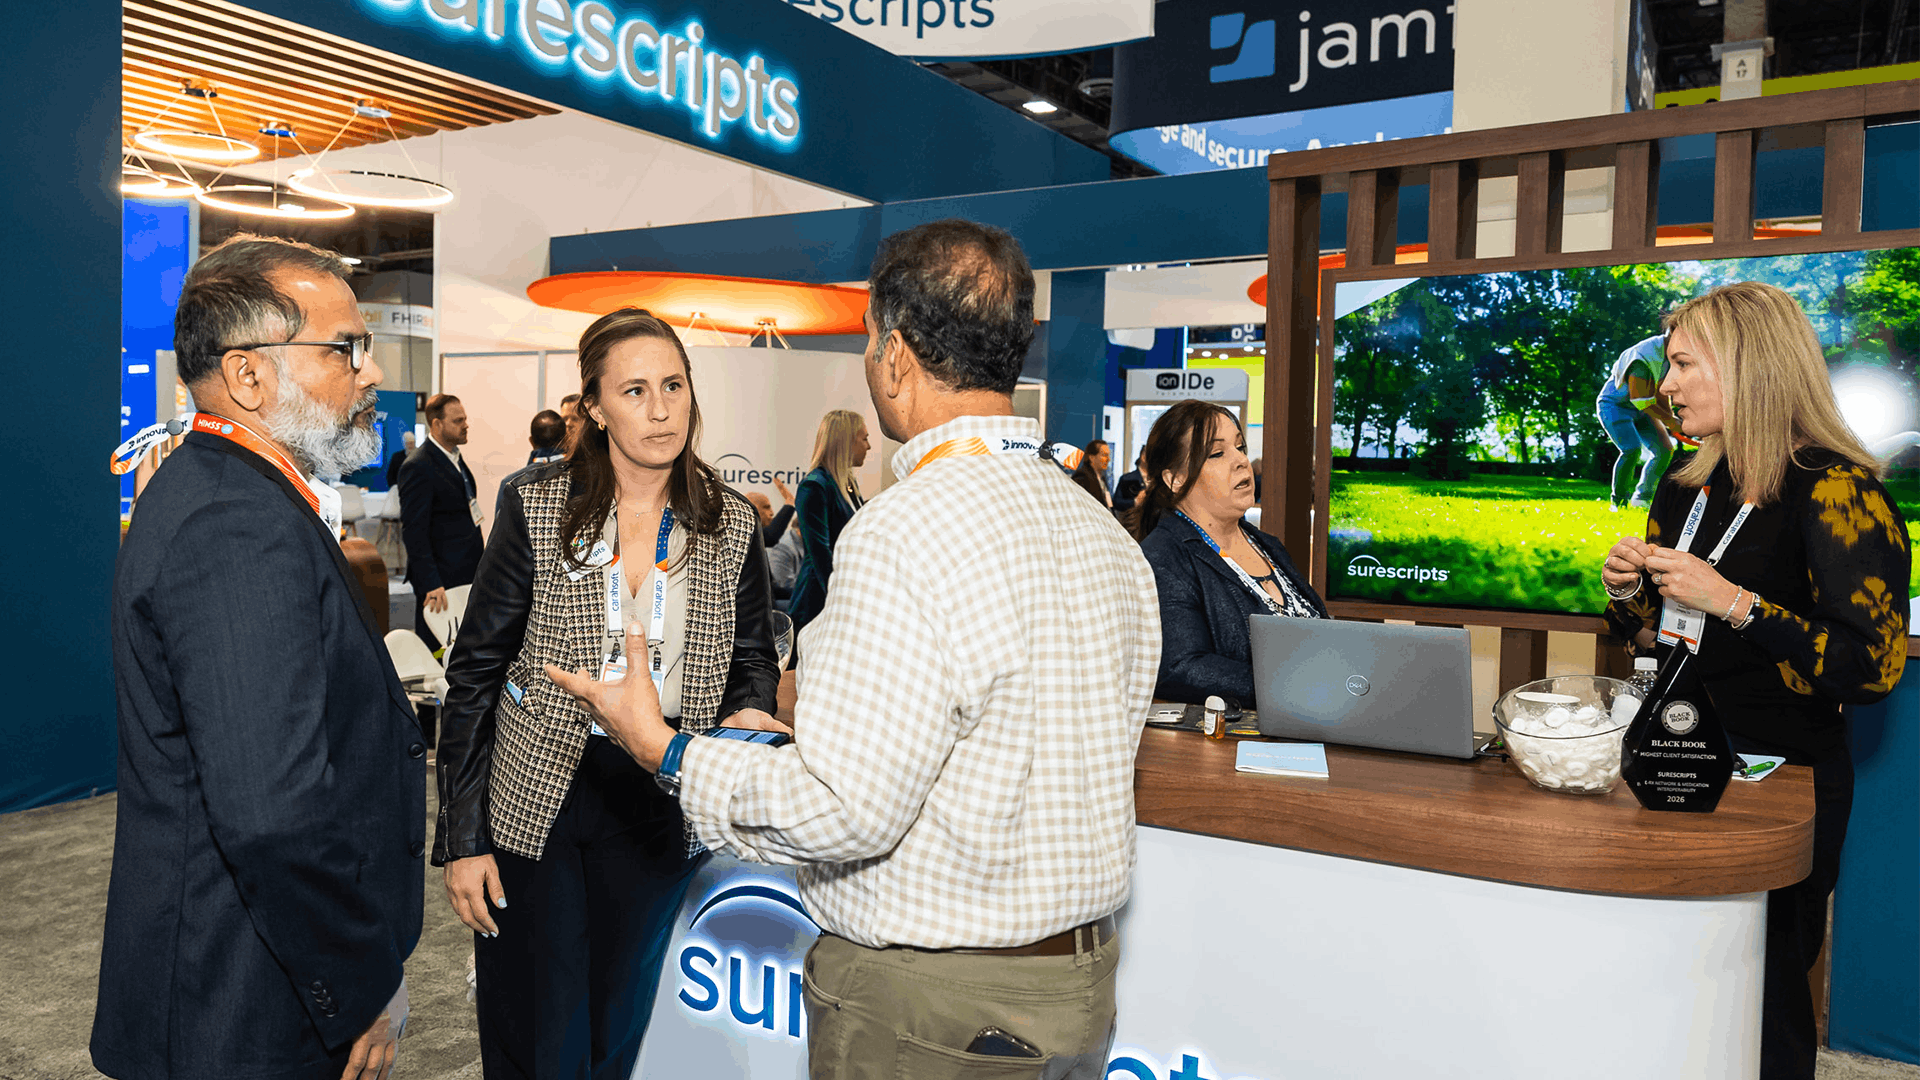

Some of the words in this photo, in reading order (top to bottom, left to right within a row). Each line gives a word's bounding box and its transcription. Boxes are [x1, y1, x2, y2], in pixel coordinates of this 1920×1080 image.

[1181, 123, 1207, 157] and
[1208, 139, 1288, 169] secur
[198, 418, 222, 431] HIMSS
[1683, 501, 1703, 536] carahsoft
[1722, 510, 1748, 545] carahsoft
[1347, 565, 1449, 583] surescripts
[610, 571, 619, 612] carahsoft
[653, 580, 664, 620] carahsoft
[1651, 740, 1680, 748] BLACK
[1657, 771, 1697, 779] SURESCRIPTS
[1666, 795, 1685, 803] 2026
